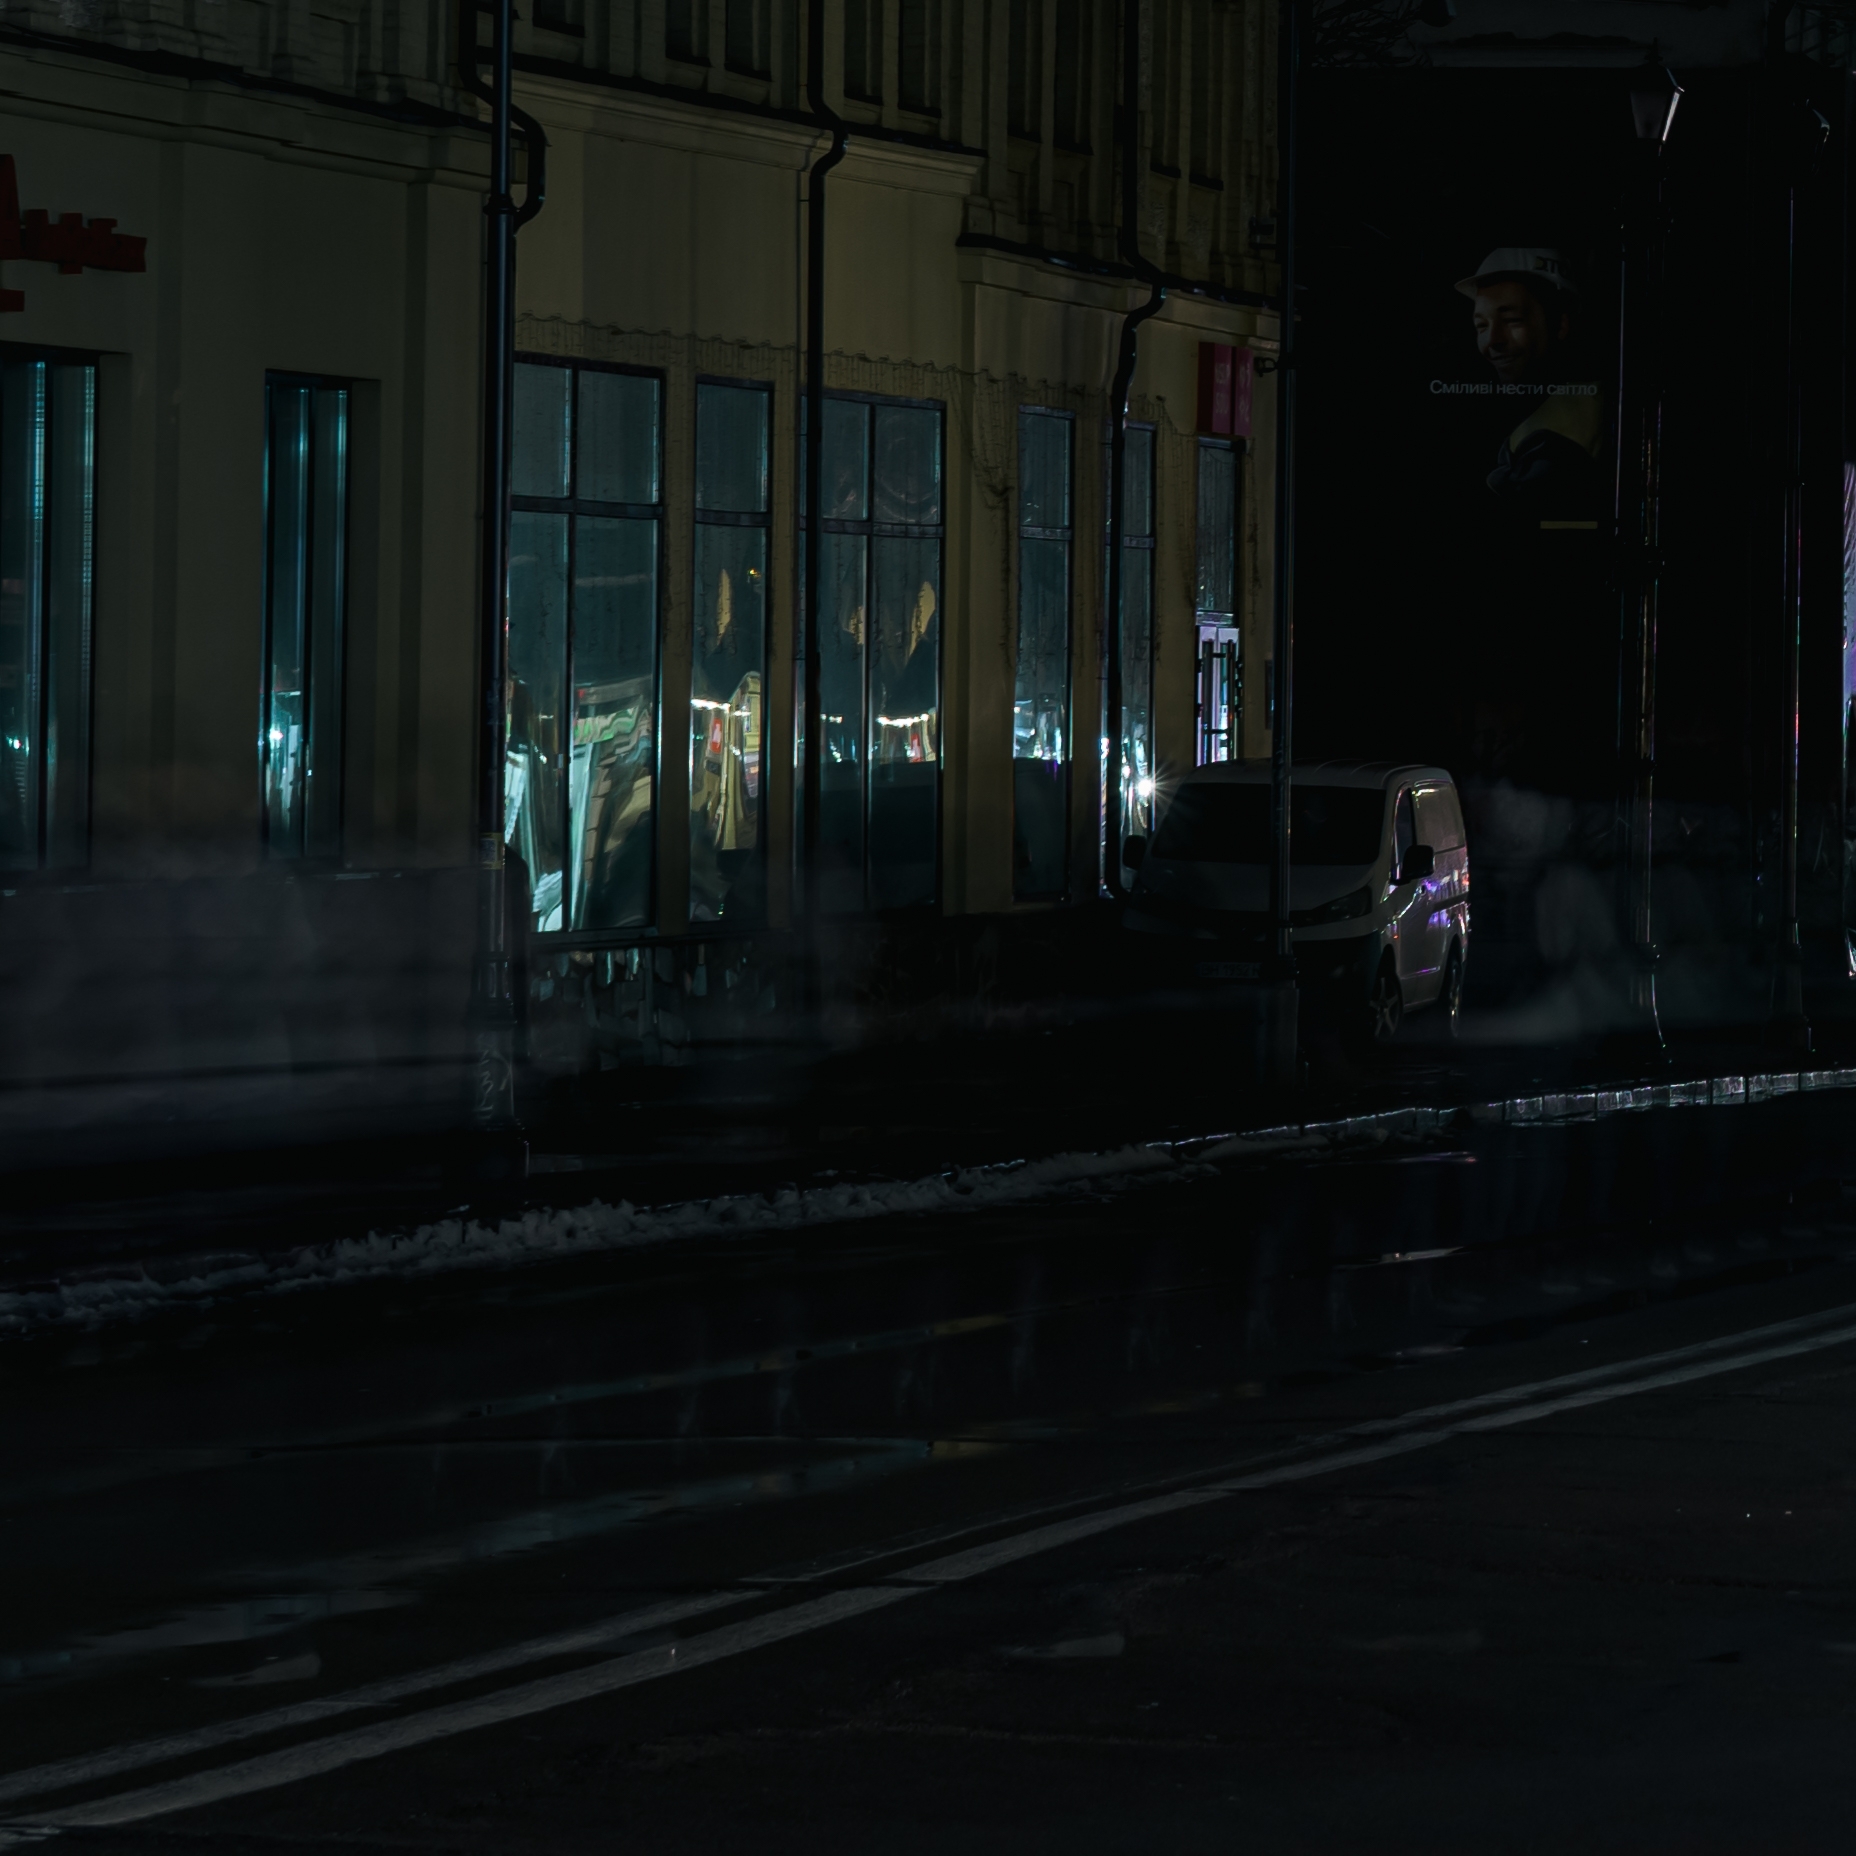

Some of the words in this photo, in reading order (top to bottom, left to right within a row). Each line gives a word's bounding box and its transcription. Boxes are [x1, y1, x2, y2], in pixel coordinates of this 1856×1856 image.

[1429, 379, 1493, 395] Сміливі
[1496, 382, 1543, 396] нести
[1546, 382, 1598, 396] світло
